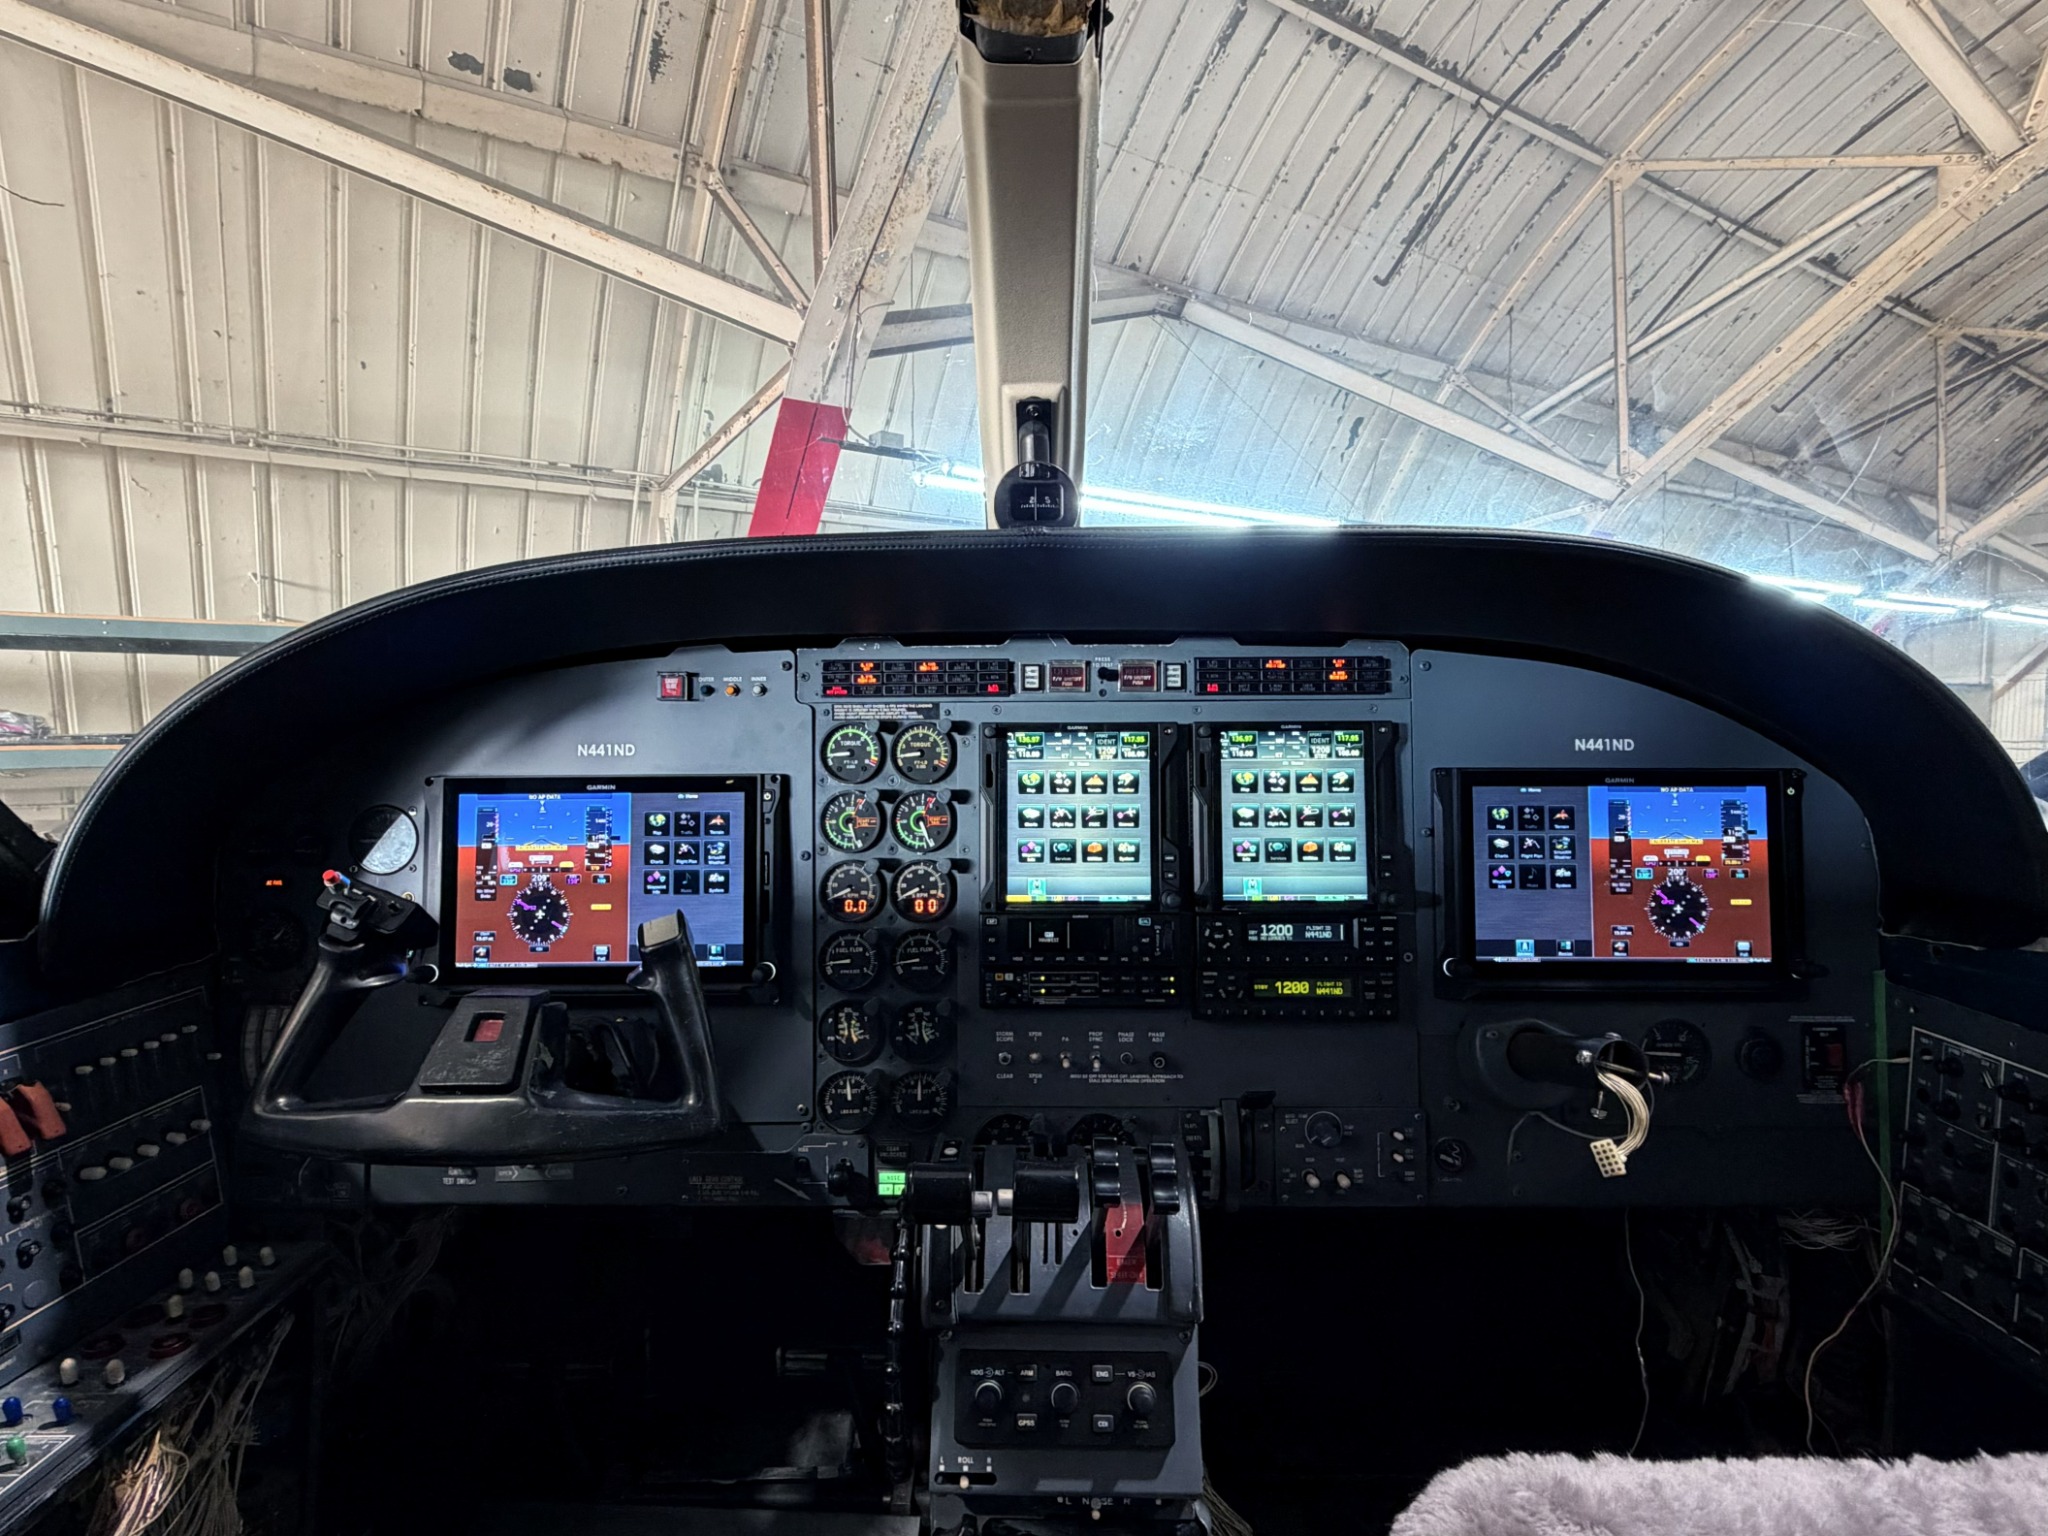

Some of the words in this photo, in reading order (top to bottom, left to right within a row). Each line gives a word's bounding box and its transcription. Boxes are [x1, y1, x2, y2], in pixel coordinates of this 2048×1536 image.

[577, 743, 635, 757] N441ND
[1574, 738, 1635, 752] N441ND
[844, 900, 867, 912] 0.0
[1260, 924, 1293, 936] 1200
[1275, 981, 1309, 994] 1200
